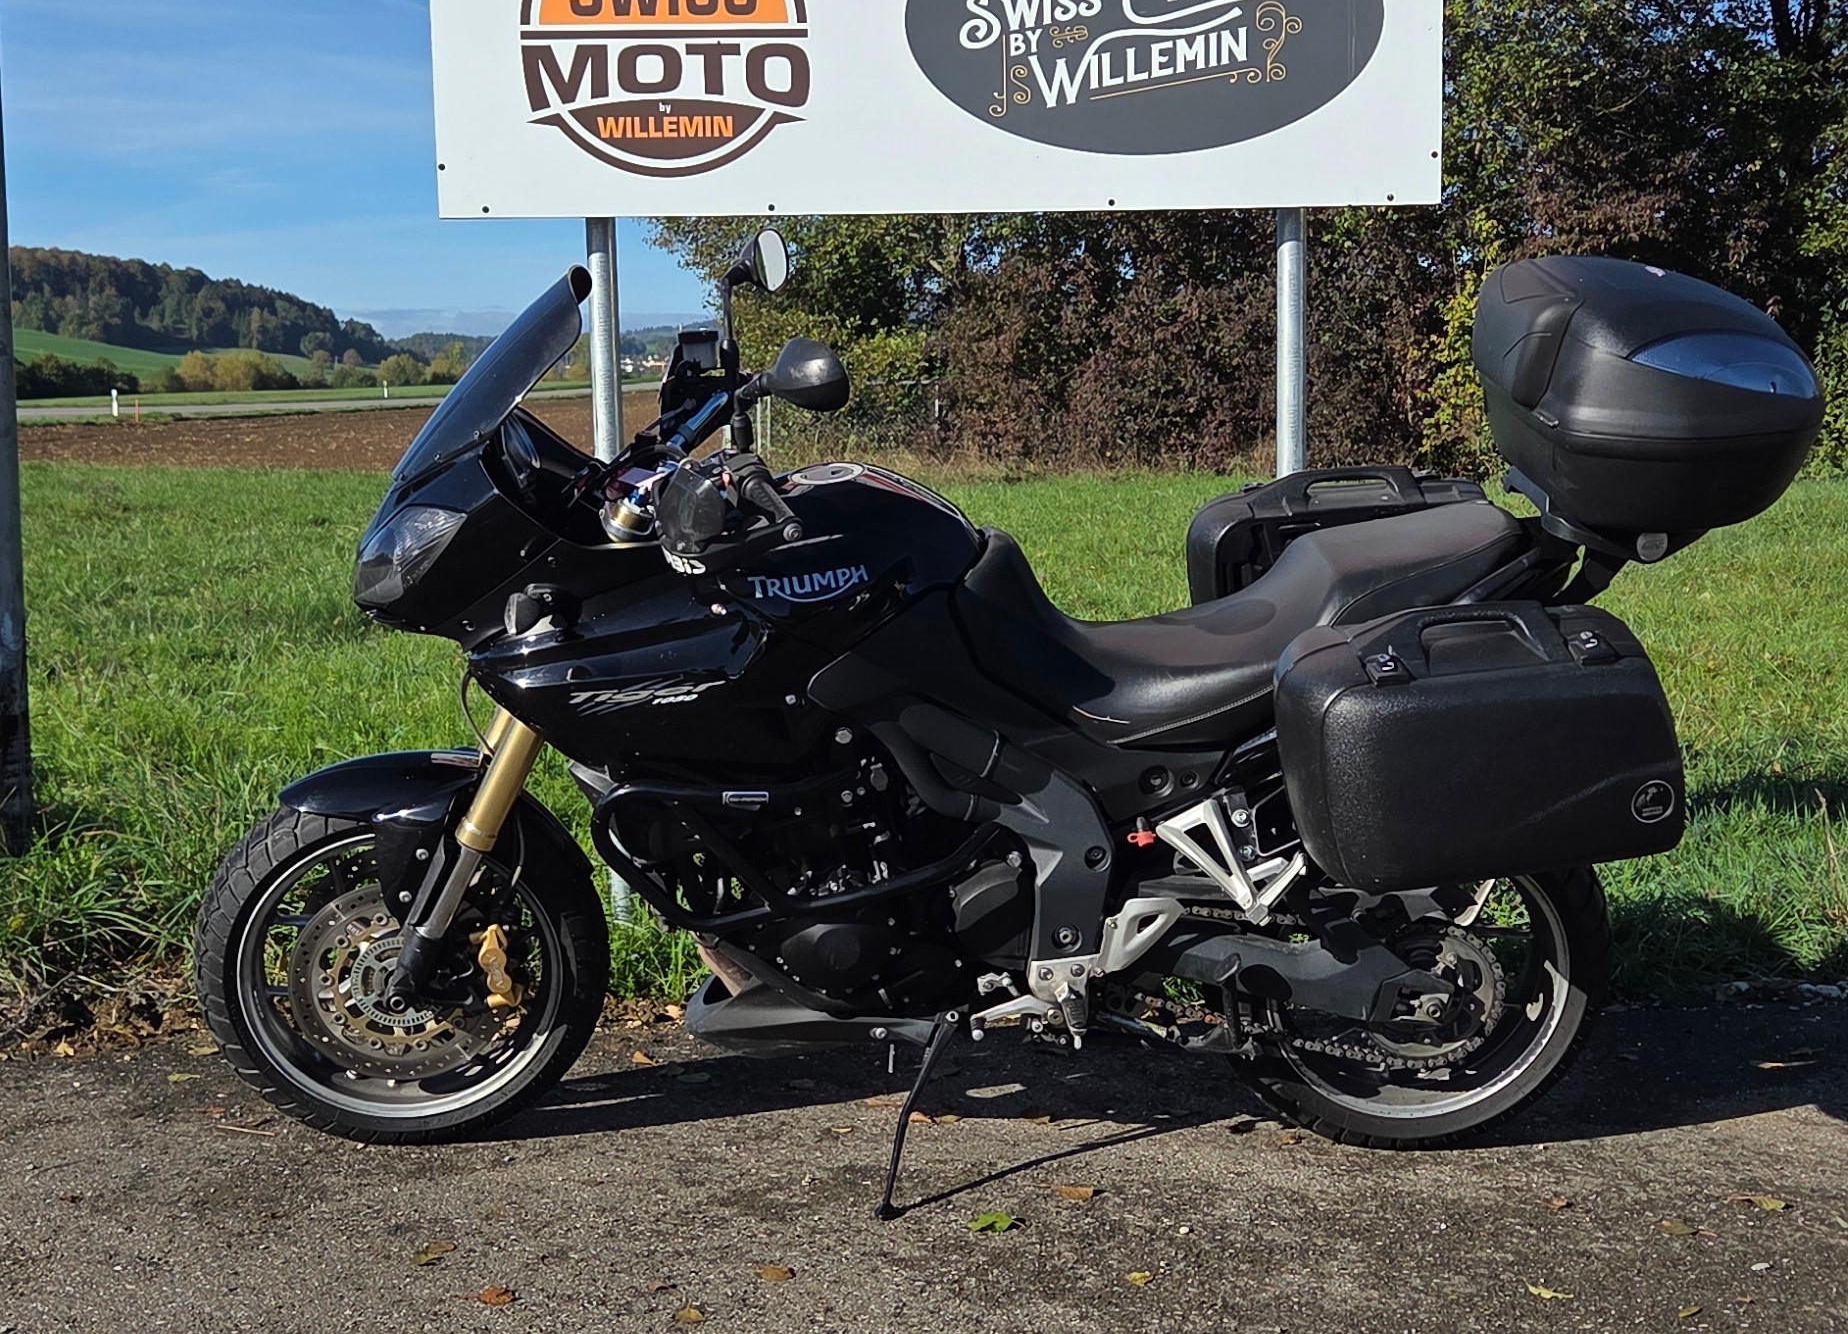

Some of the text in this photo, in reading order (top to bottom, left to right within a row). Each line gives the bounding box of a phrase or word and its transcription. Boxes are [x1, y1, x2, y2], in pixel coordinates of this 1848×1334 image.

[1008, 27, 1044, 58] BY
[520, 41, 812, 113] MOTO
[657, 101, 673, 114] by
[596, 115, 735, 140] WILLEMIN
[746, 564, 869, 602] TRIUMPH
[568, 679, 727, 705] Tiger
